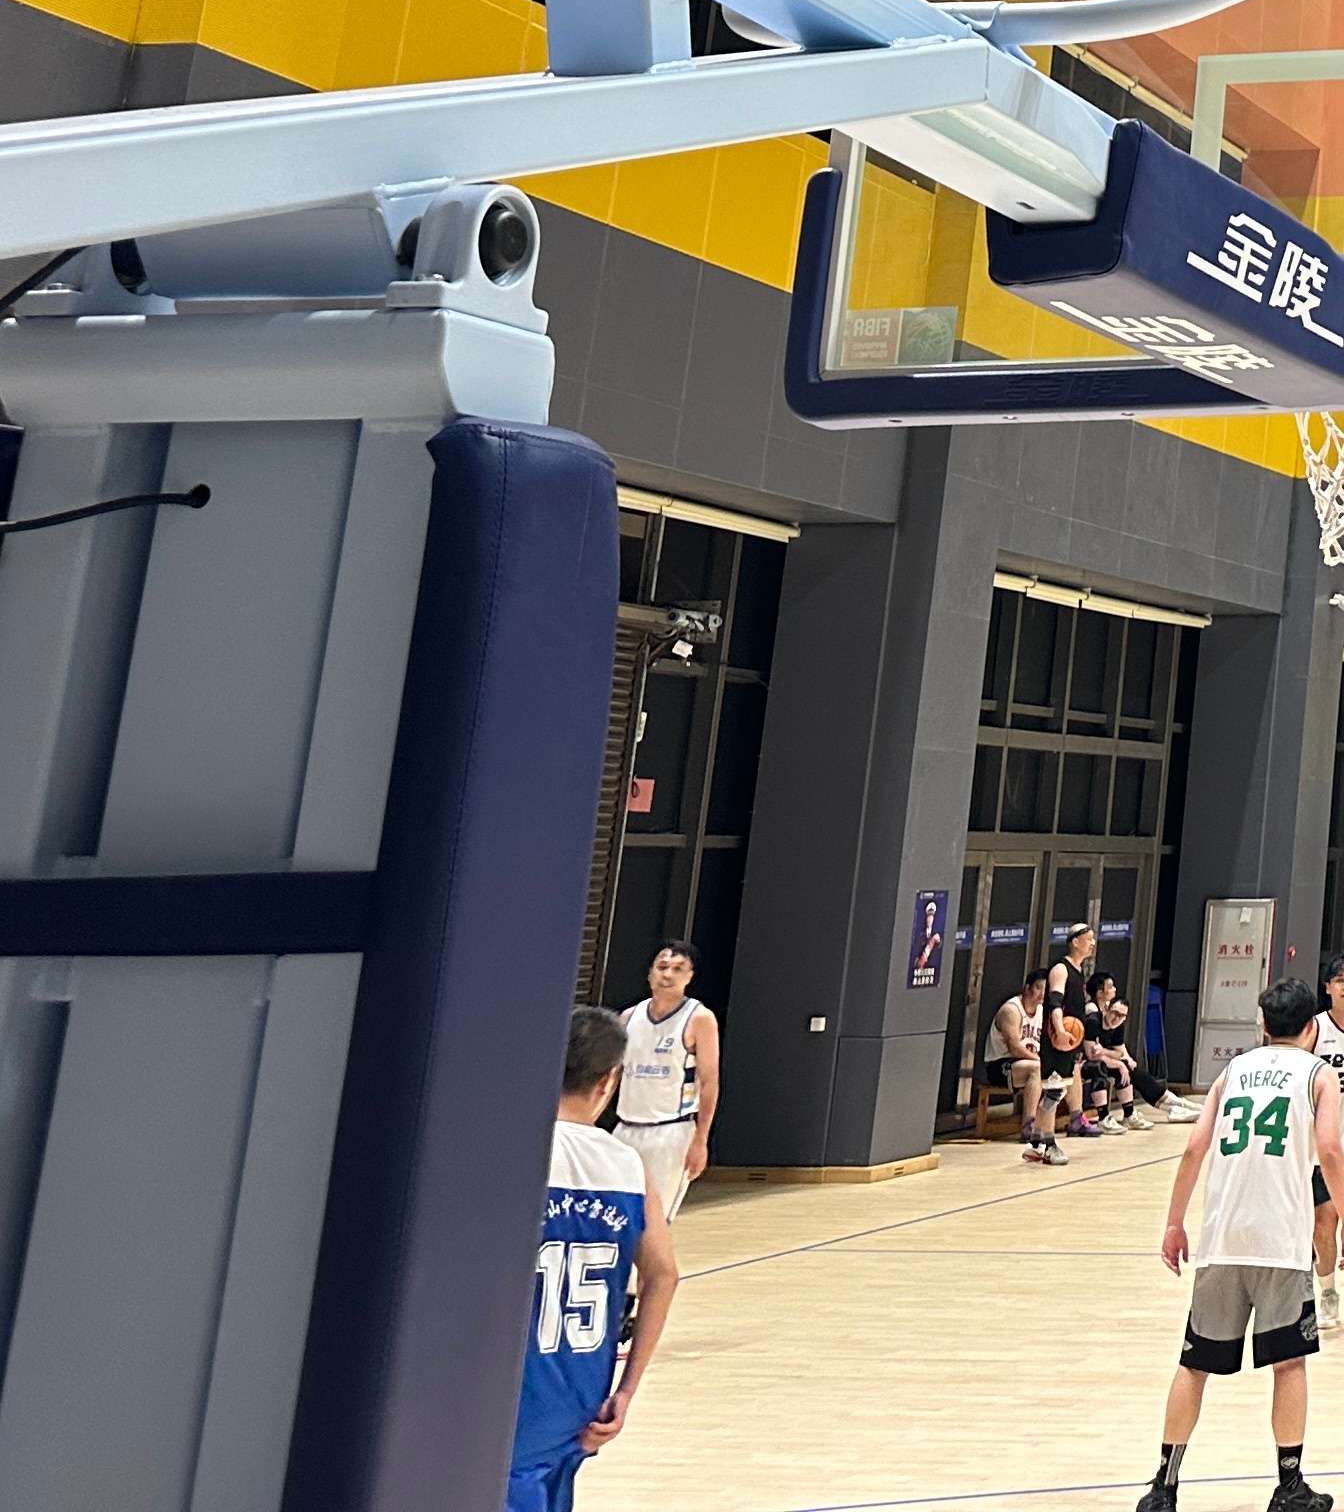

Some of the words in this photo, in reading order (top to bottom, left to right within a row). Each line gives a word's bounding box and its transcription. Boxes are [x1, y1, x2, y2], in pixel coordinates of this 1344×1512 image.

[1186, 212, 1344, 349] 金陵
[1050, 301, 1275, 384] 金陵
[1218, 944, 1255, 955] 消火栓
[1239, 1070, 1292, 1091] PIERCE
[1220, 1095, 1291, 1157] 34
[536, 1240, 620, 1354] 15
